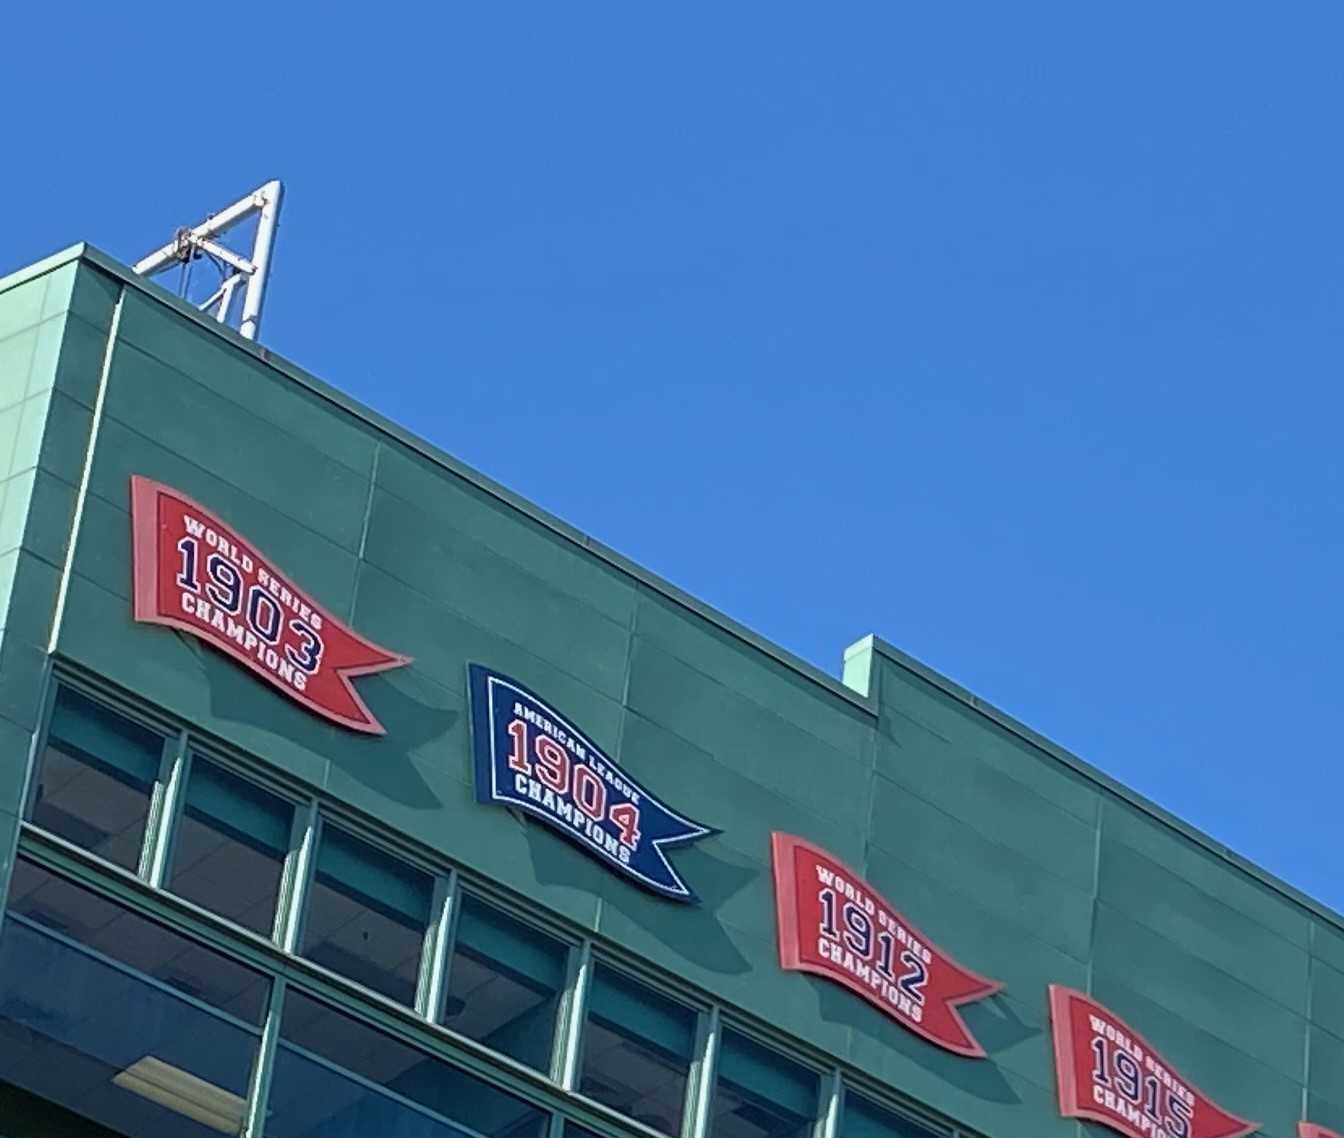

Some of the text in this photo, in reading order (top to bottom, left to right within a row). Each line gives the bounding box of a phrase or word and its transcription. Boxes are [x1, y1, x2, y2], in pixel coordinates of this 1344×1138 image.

[177, 536, 324, 675] 1903
[184, 514, 322, 630] WORLD SERIES
[182, 592, 307, 690] CHAMPIONS
[508, 719, 641, 851] 1904
[513, 702, 640, 805] AMERICAN LEAGUE
[515, 773, 631, 864] CHAMPIONS
[816, 865, 932, 965] WORLD SERIES
[818, 887, 929, 1006] 1912
[818, 937, 923, 1023] CHAMPIONS
[1088, 1014, 1196, 1107] WORLD SERIES
